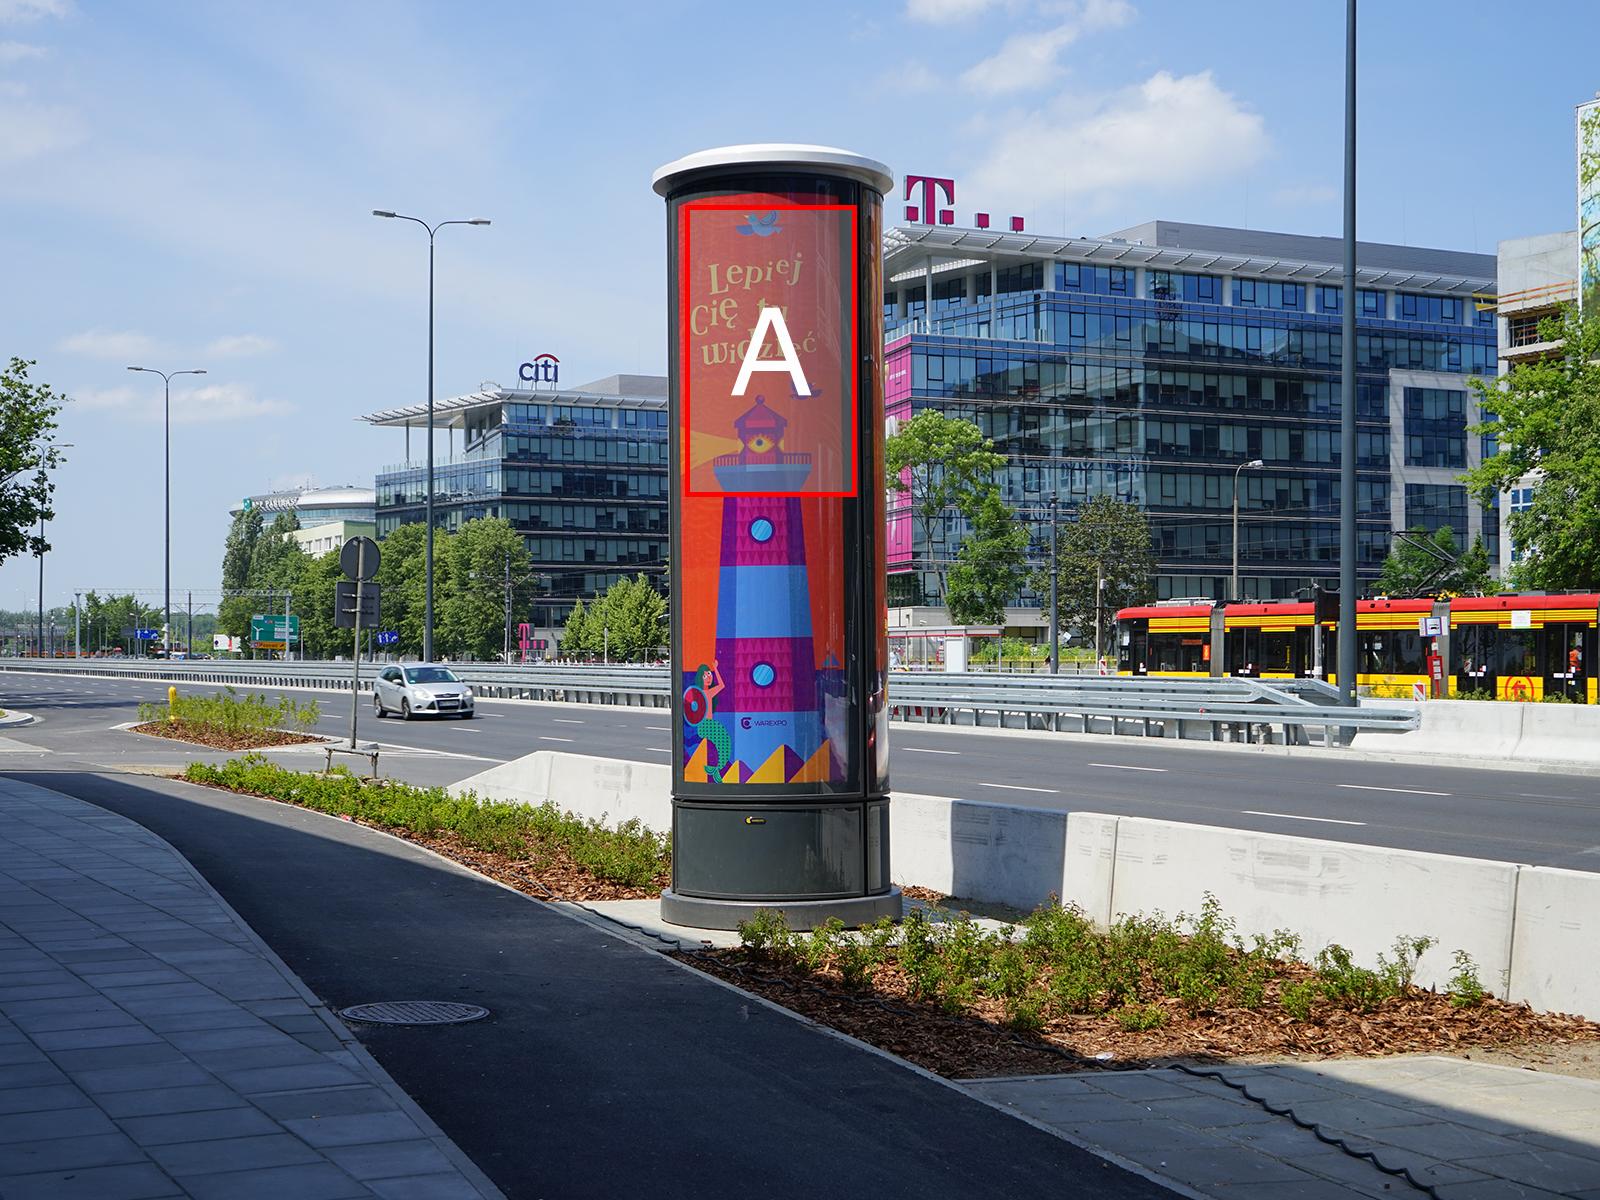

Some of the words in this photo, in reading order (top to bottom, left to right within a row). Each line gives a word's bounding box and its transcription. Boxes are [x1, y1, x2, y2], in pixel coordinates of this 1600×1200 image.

[707, 252, 804, 295] Lepiej
[690, 297, 738, 336] Cię
[518, 357, 559, 383] citi
[754, 719, 788, 727] WAREXPO
